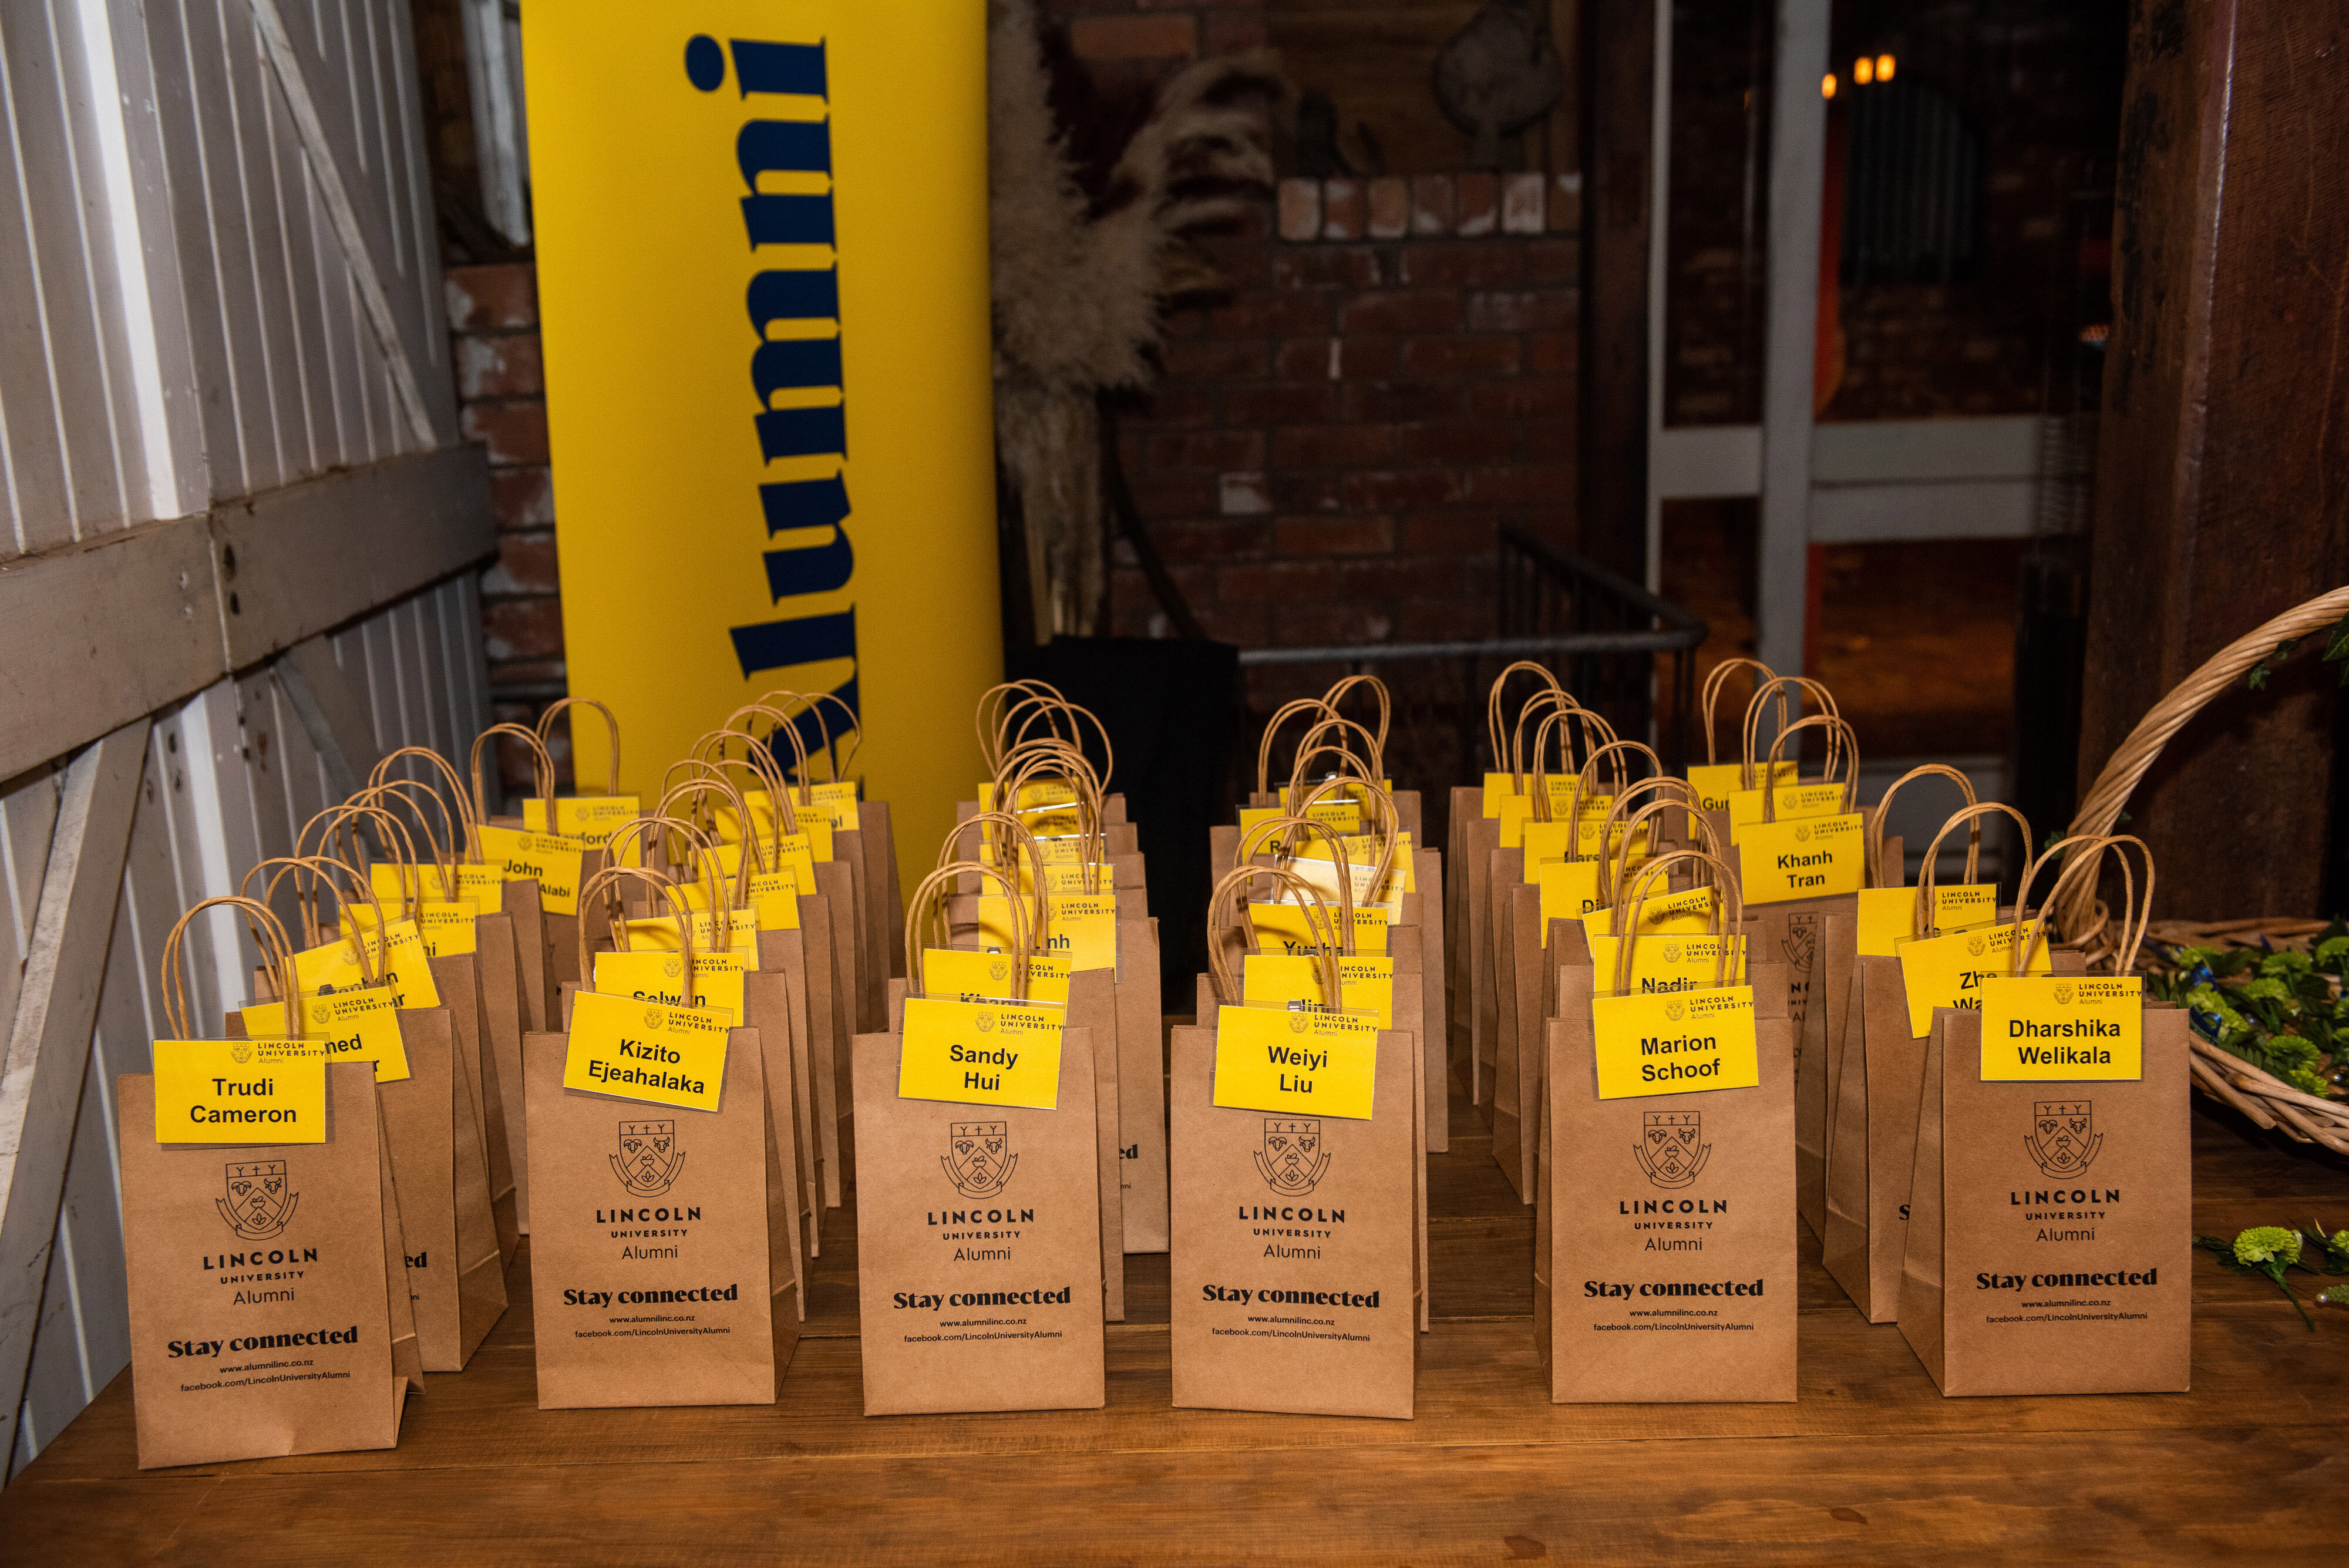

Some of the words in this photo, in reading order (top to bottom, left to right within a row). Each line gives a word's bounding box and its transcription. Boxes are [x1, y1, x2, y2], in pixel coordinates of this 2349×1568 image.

[1814, 821, 1848, 829] LINCOLN
[1815, 825, 1863, 835] UNIVERSITY
[1777, 850, 1833, 869] Khanh
[503, 859, 543, 877] John
[1786, 874, 1825, 888] Tran
[1668, 896, 1707, 909] LINCOLN
[1671, 913, 1692, 921] Alumni
[1991, 945, 2013, 954] Alumni
[333, 997, 374, 1008] LINCOLN
[1689, 995, 1735, 1006] LINCOLN
[1690, 1001, 1754, 1013] UNIVERSITY
[335, 1001, 393, 1015] UNIVERSITY
[668, 1012, 712, 1024] LINCOLN
[1001, 1013, 1045, 1022] LINCOLN
[1314, 1014, 1359, 1024] LINCOLN
[1691, 1012, 1715, 1020] Alumni
[667, 1026, 691, 1035] Alumni
[668, 1019, 729, 1034] UNIVERSITY
[999, 1028, 1024, 1036] Alumni
[1000, 1020, 1063, 1031] UNIVERSITY
[1314, 1021, 1378, 1032] UNIVERSITY
[2009, 1018, 2121, 1038] Dharshika
[618, 1039, 681, 1064] Kizito
[1640, 1034, 1717, 1056] Marion
[257, 1049, 325, 1057] UNIVERSITY
[949, 1044, 1019, 1070] Sandy
[1267, 1045, 1328, 1071] Weiyi
[2018, 1045, 2112, 1065] Welikala
[1641, 1058, 1721, 1082] Schoof
[588, 1061, 705, 1095] Ejeahalaka
[964, 1071, 1000, 1091] Hui
[1279, 1073, 1313, 1094] Liu
[212, 1078, 274, 1096] Trudi
[190, 1105, 297, 1123] Cameron
[2010, 1189, 2120, 1205] LINCOLN
[1620, 1199, 1728, 1214] LINCOLN
[595, 1207, 702, 1224] LINCOLN
[927, 1209, 1035, 1226] LINCOLN
[1238, 1206, 1346, 1224] LINCOLN
[2025, 1212, 2106, 1220] UNIVERSITY
[1634, 1221, 1714, 1230] UNIVERSITY
[611, 1229, 688, 1237] UNIVERSITY
[942, 1230, 1021, 1240] UNIVERSITY
[1253, 1228, 1331, 1238] UNIVERSITY
[2036, 1227, 2095, 1243] Alumni
[1644, 1237, 1703, 1251] Alumni
[203, 1247, 318, 1270] LINCOLN
[621, 1244, 678, 1260] Alumni
[953, 1247, 1011, 1261] Alumni
[1263, 1243, 1321, 1260] Alumni
[220, 1270, 305, 1284] UNIVERSITY
[1976, 1271, 2027, 1293] Stay
[2031, 1267, 2158, 1287] connected
[233, 1287, 295, 1305] Alumni
[563, 1288, 614, 1307] Stay
[617, 1283, 738, 1304] connected
[1202, 1284, 1254, 1305] Stay
[1258, 1289, 1379, 1308] connected
[1584, 1280, 1635, 1301] Stay
[1639, 1278, 1764, 1297] connected
[893, 1291, 945, 1311] Stay
[949, 1286, 1071, 1306] connected
[2021, 1298, 2111, 1308] www.alumnilinc.co.nz
[609, 1314, 696, 1323] www.alumnilinc.co.nz
[1247, 1314, 1335, 1326] www.alumnilinc.co.nz
[1629, 1308, 1718, 1318] www.alumnilinc.co.nz
[1985, 1312, 2148, 1324] facebook.com/LincolnUniversityAlumni
[940, 1317, 1027, 1327] www.alumnilinc.co.nz
[1593, 1322, 1754, 1333] facebook.com/LincolnUniversityAlumni
[574, 1327, 731, 1339] facebook.com/LincolnUniversityAlumni
[904, 1330, 1062, 1343] facebook.com/LincolnUniversityAlumni
[1211, 1327, 1371, 1342] facebook.com/LincolnUniversityAlumni
[167, 1337, 224, 1360] Stay
[229, 1325, 358, 1351] connected
[219, 1358, 314, 1374] www.alumnilinc.co.nz
[180, 1371, 351, 1392] facebook.com/LincolnUniversityAlumni
